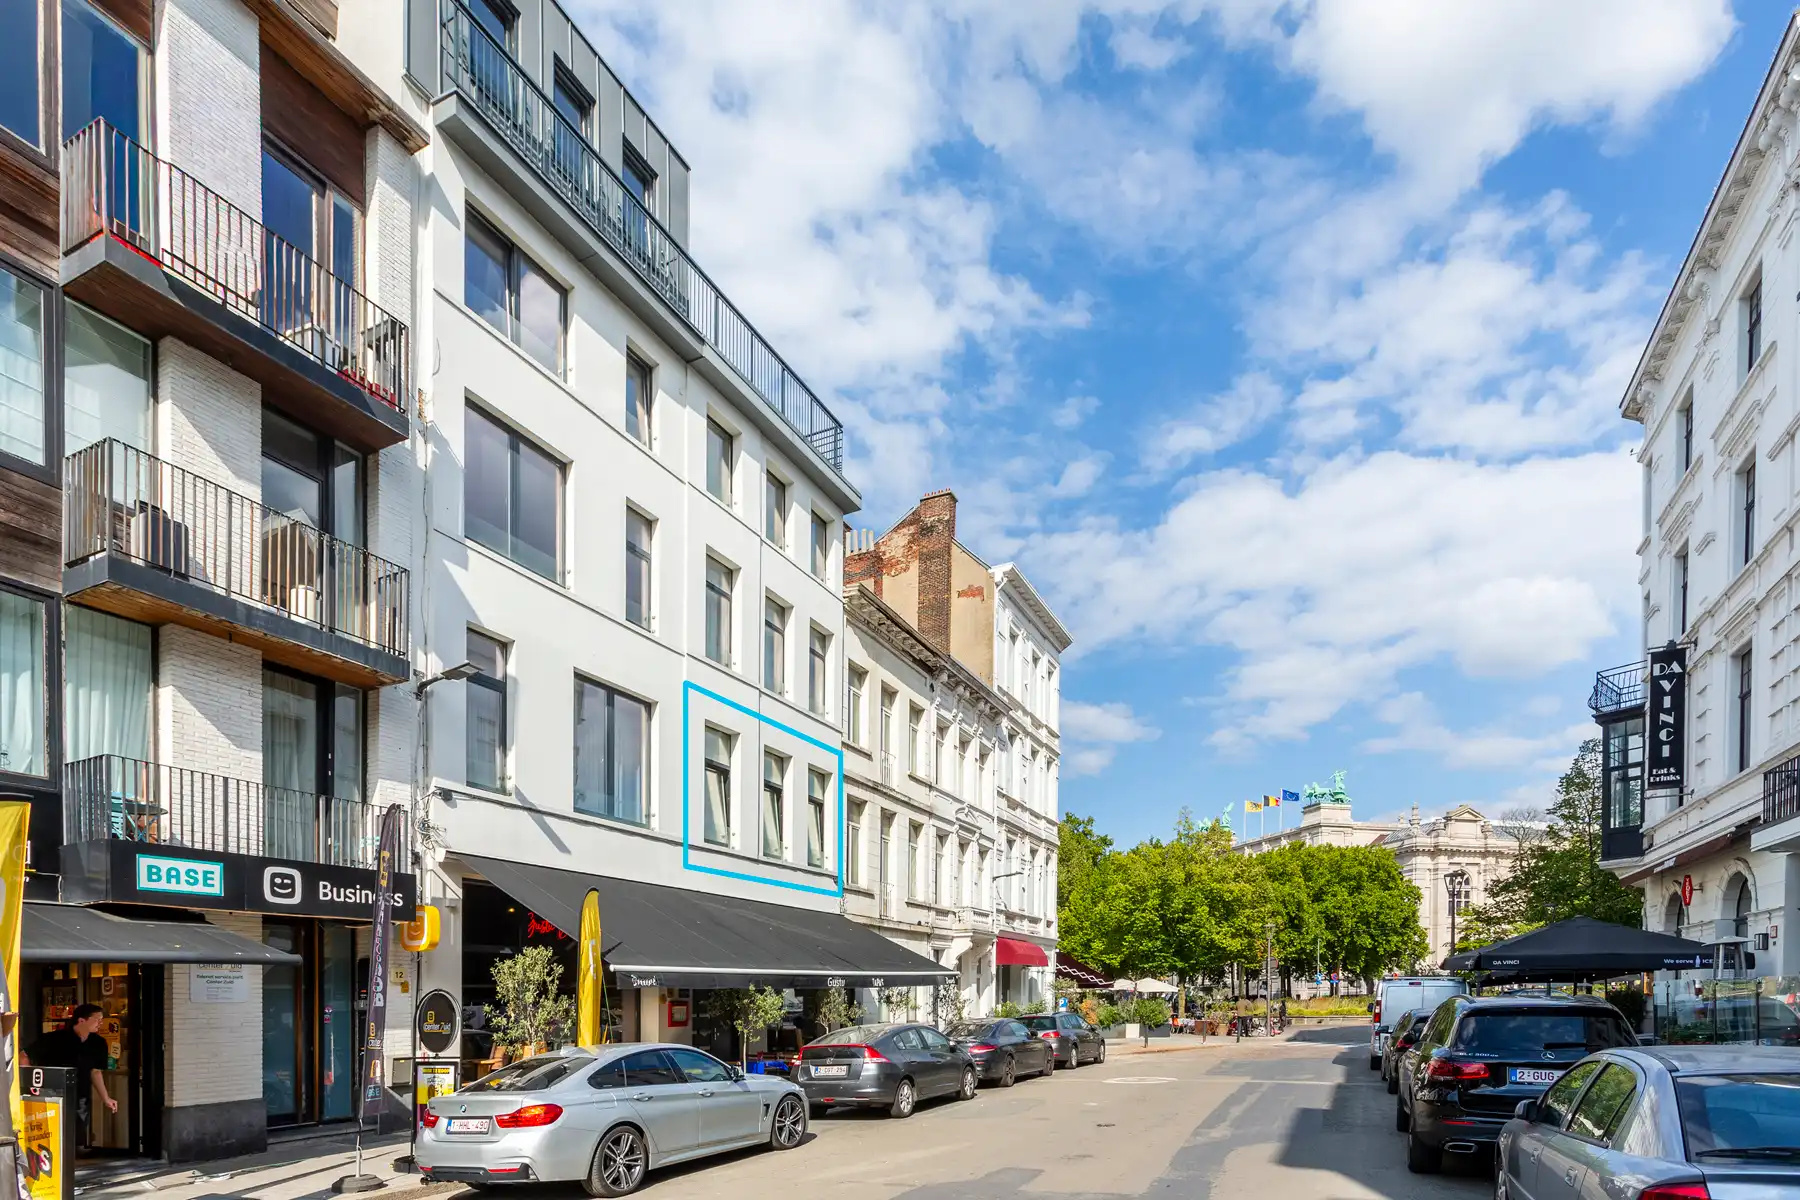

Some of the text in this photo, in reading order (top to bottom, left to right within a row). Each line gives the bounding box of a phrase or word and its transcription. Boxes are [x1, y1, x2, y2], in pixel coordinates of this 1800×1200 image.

[1652, 660, 1684, 677] DA
[1658, 678, 1677, 758] VINCI
[1649, 774, 1681, 783] Drinks
[146, 864, 215, 888] BASE
[394, 971, 404, 979] 12
[452, 1121, 489, 1130] 1-HHL-490
